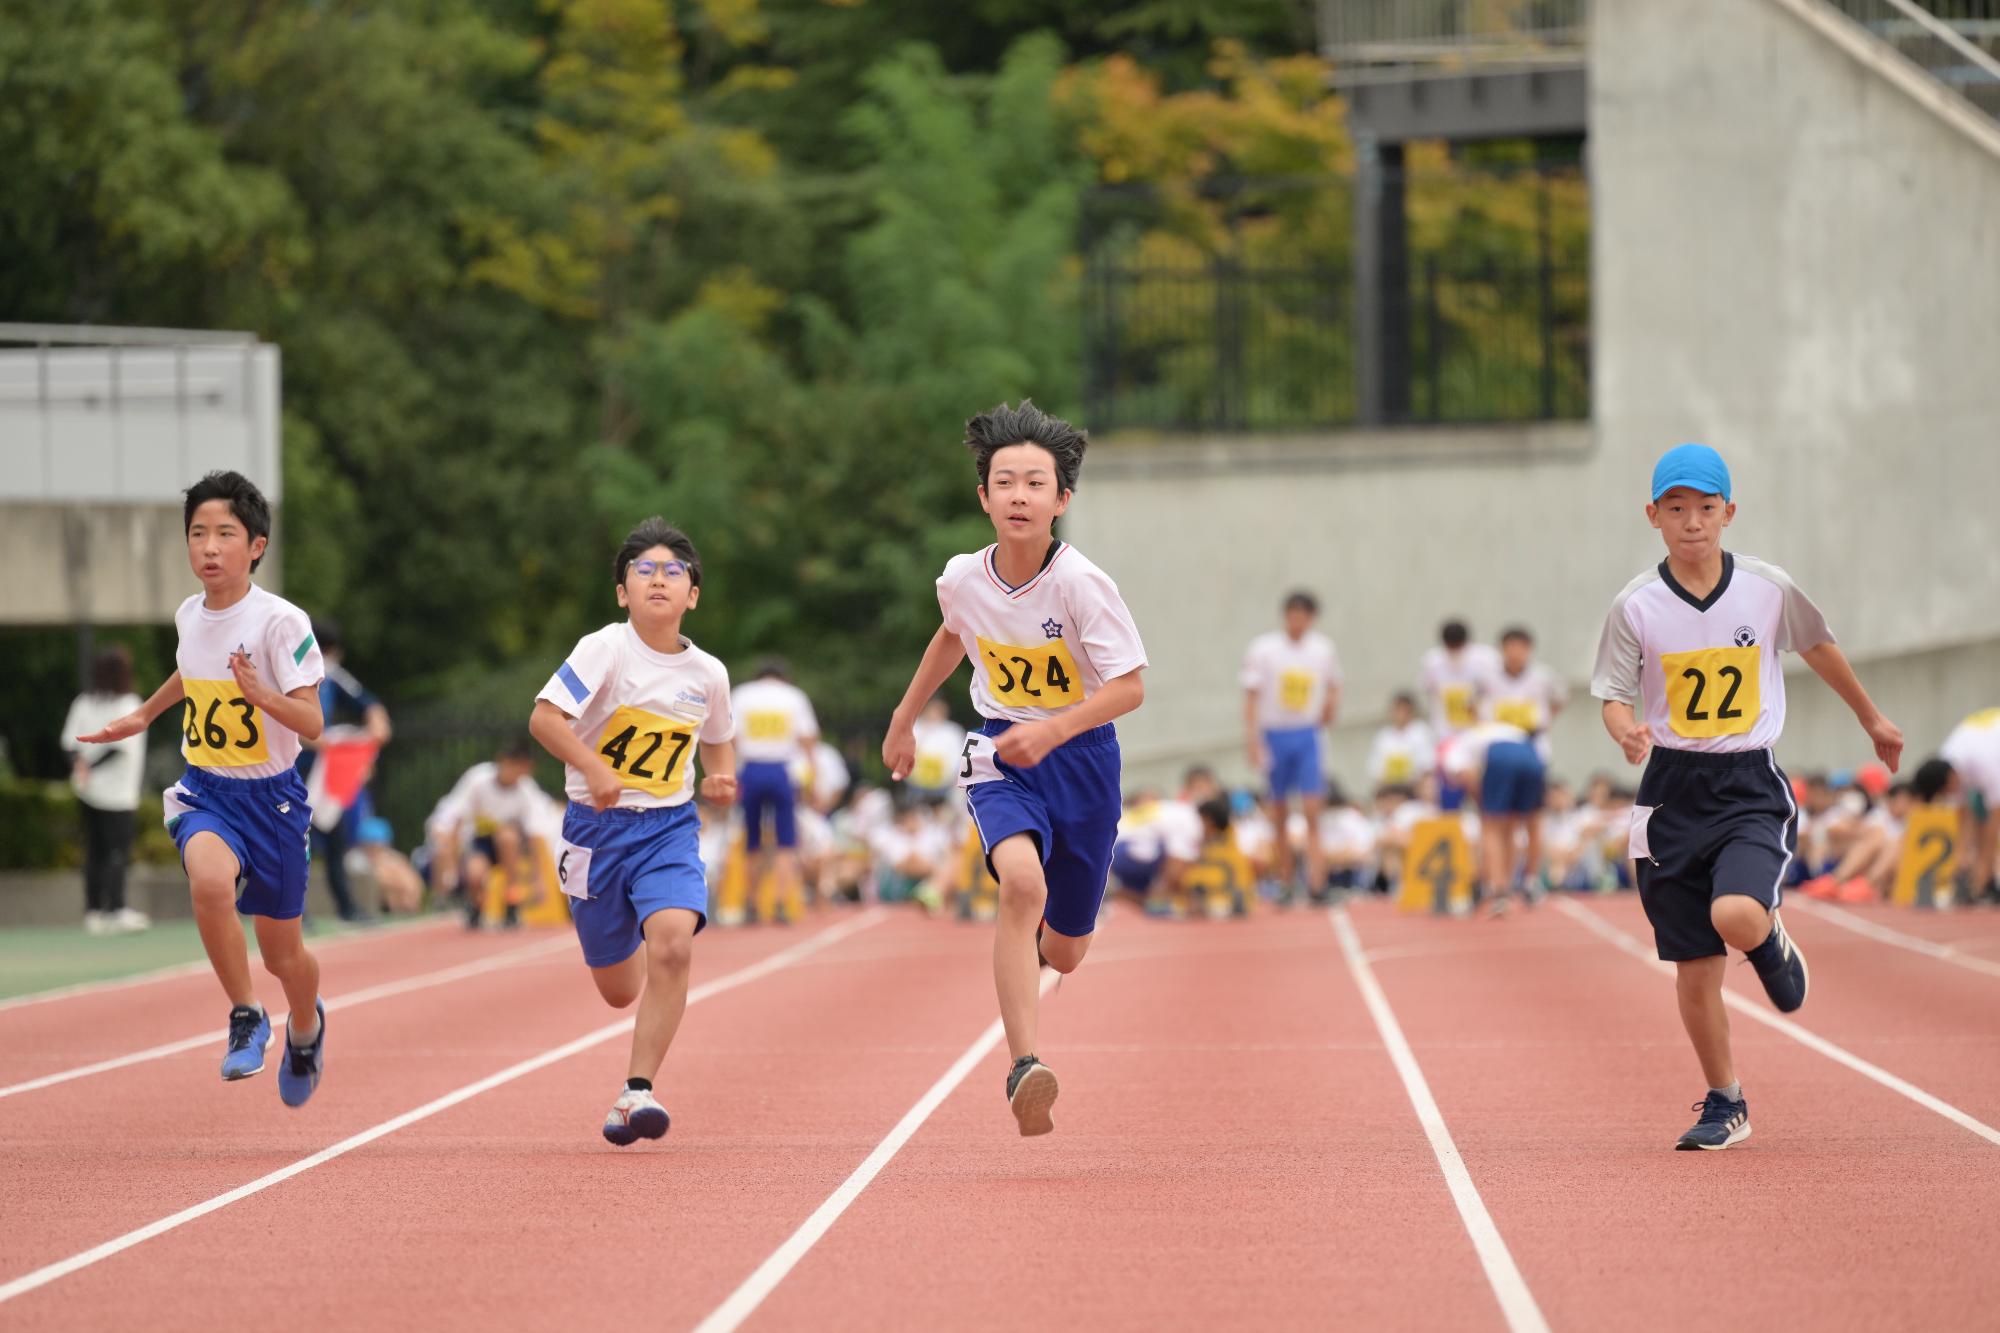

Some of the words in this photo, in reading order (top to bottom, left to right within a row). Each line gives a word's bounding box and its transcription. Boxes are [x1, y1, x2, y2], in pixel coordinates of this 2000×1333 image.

[1682, 665, 1743, 721] 22
[601, 724, 691, 782] 427
[960, 738, 980, 778] 5
